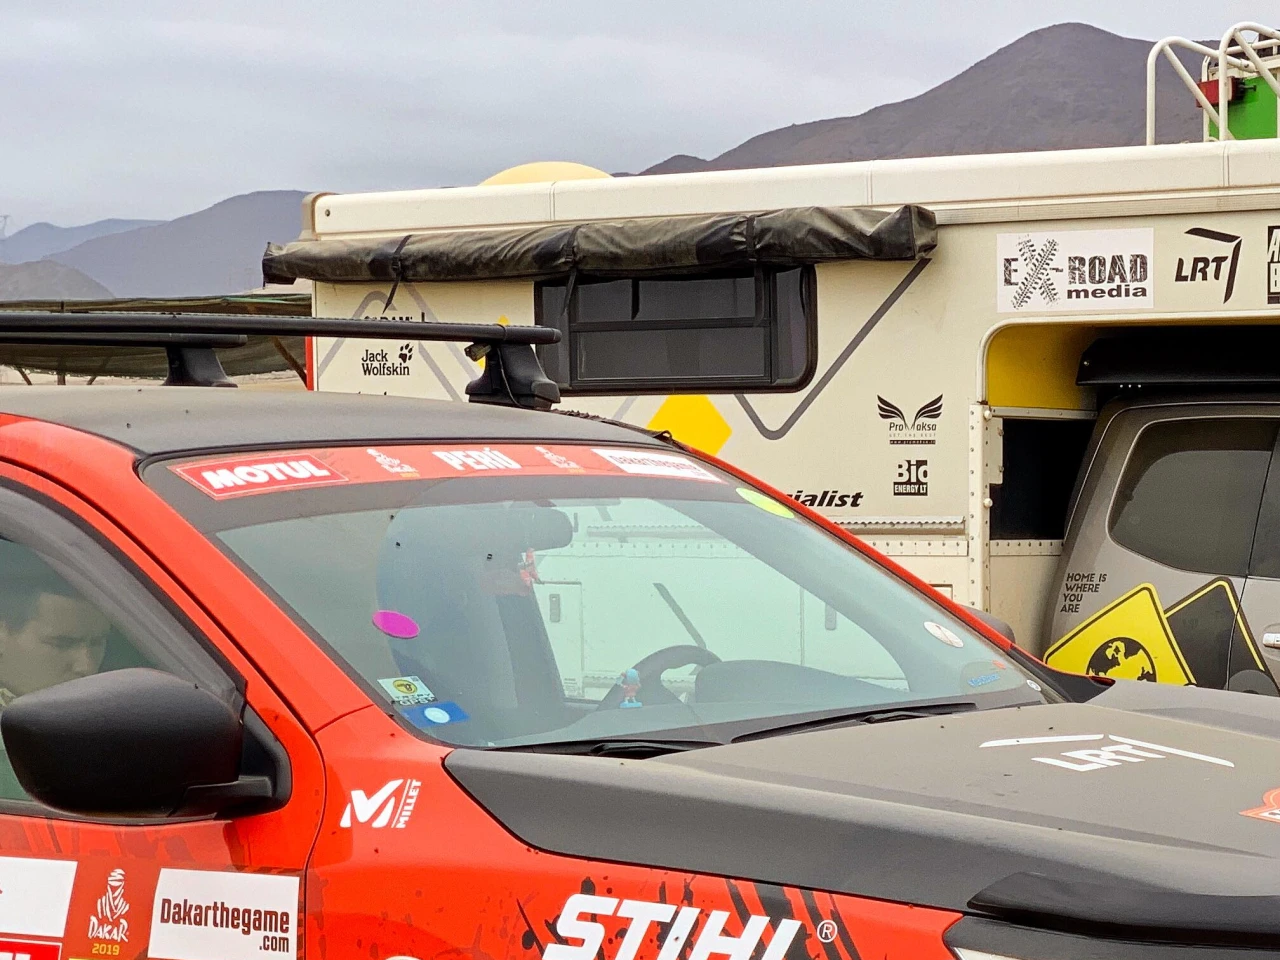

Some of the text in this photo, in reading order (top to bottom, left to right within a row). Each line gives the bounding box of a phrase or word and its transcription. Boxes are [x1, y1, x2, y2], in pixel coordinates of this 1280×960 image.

[1174, 255, 1230, 283] LRT
[1066, 284, 1148, 299] media
[361, 349, 389, 363] Jack
[361, 362, 411, 376] Wolfskin
[200, 460, 331, 490] MOTUL
[894, 484, 927, 494] ENERGY LT
[1066, 573, 1107, 583] HOME IS
[1065, 583, 1100, 593] WHERE
[1063, 593, 1083, 603] YOU
[1060, 603, 1080, 613] ARE
[396, 779, 422, 829] MILLET
[160, 898, 290, 936] Dakarthegame
[87, 915, 129, 943] DAKAR
[91, 943, 120, 956] 2019
[259, 935, 290, 953] .com
